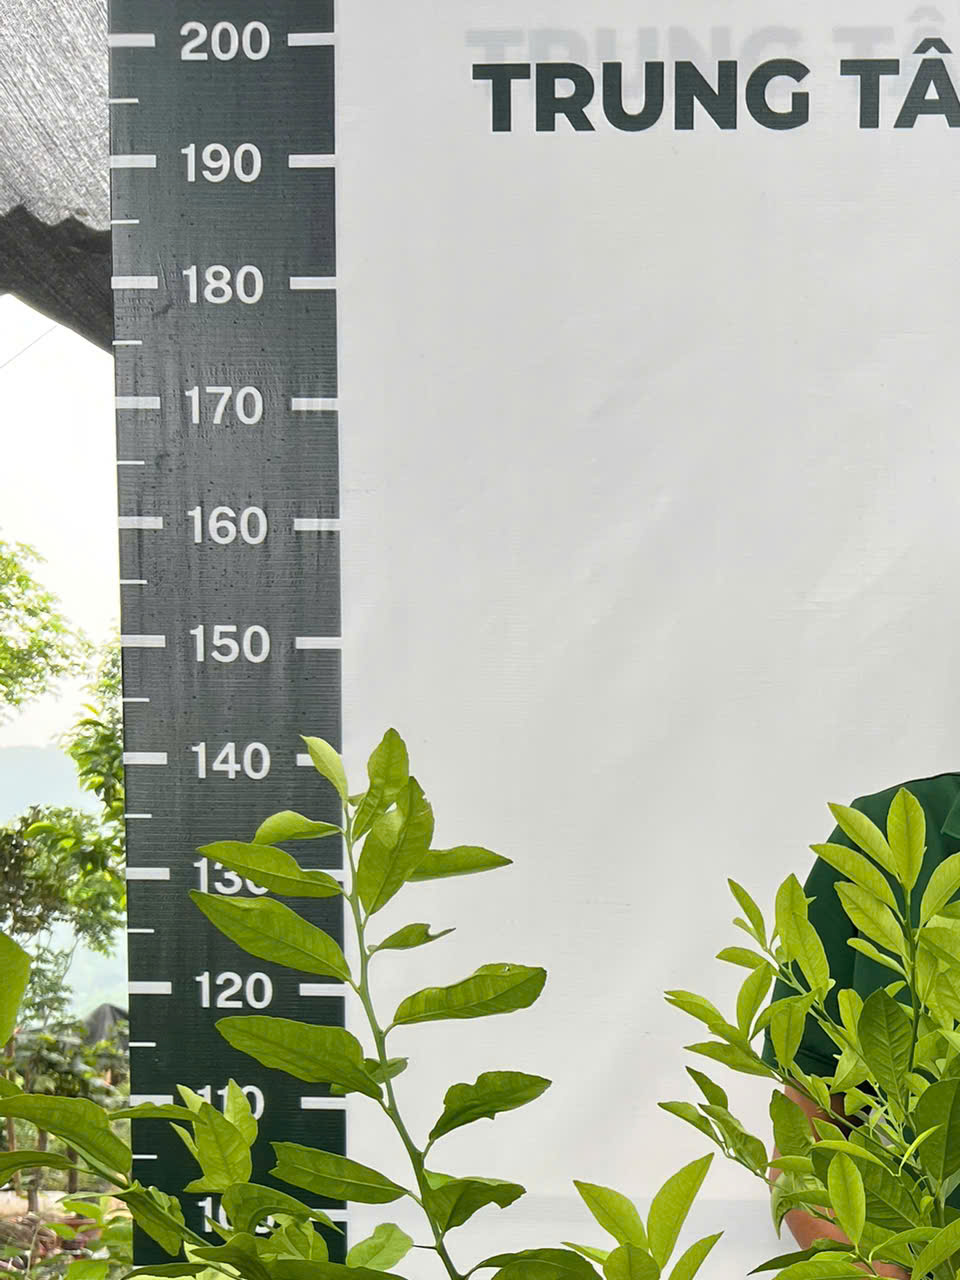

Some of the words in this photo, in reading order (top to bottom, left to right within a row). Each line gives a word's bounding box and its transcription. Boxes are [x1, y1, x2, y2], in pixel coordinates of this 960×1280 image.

[180, 21, 270, 60] 200
[472, 59, 810, 132] TRUNG
[181, 143, 261, 182] 190
[182, 265, 263, 304] 180
[184, 387, 263, 423] 170
[187, 507, 267, 544] 160
[189, 624, 270, 663] 150
[192, 742, 270, 779] 140
[196, 972, 272, 1008] 120
